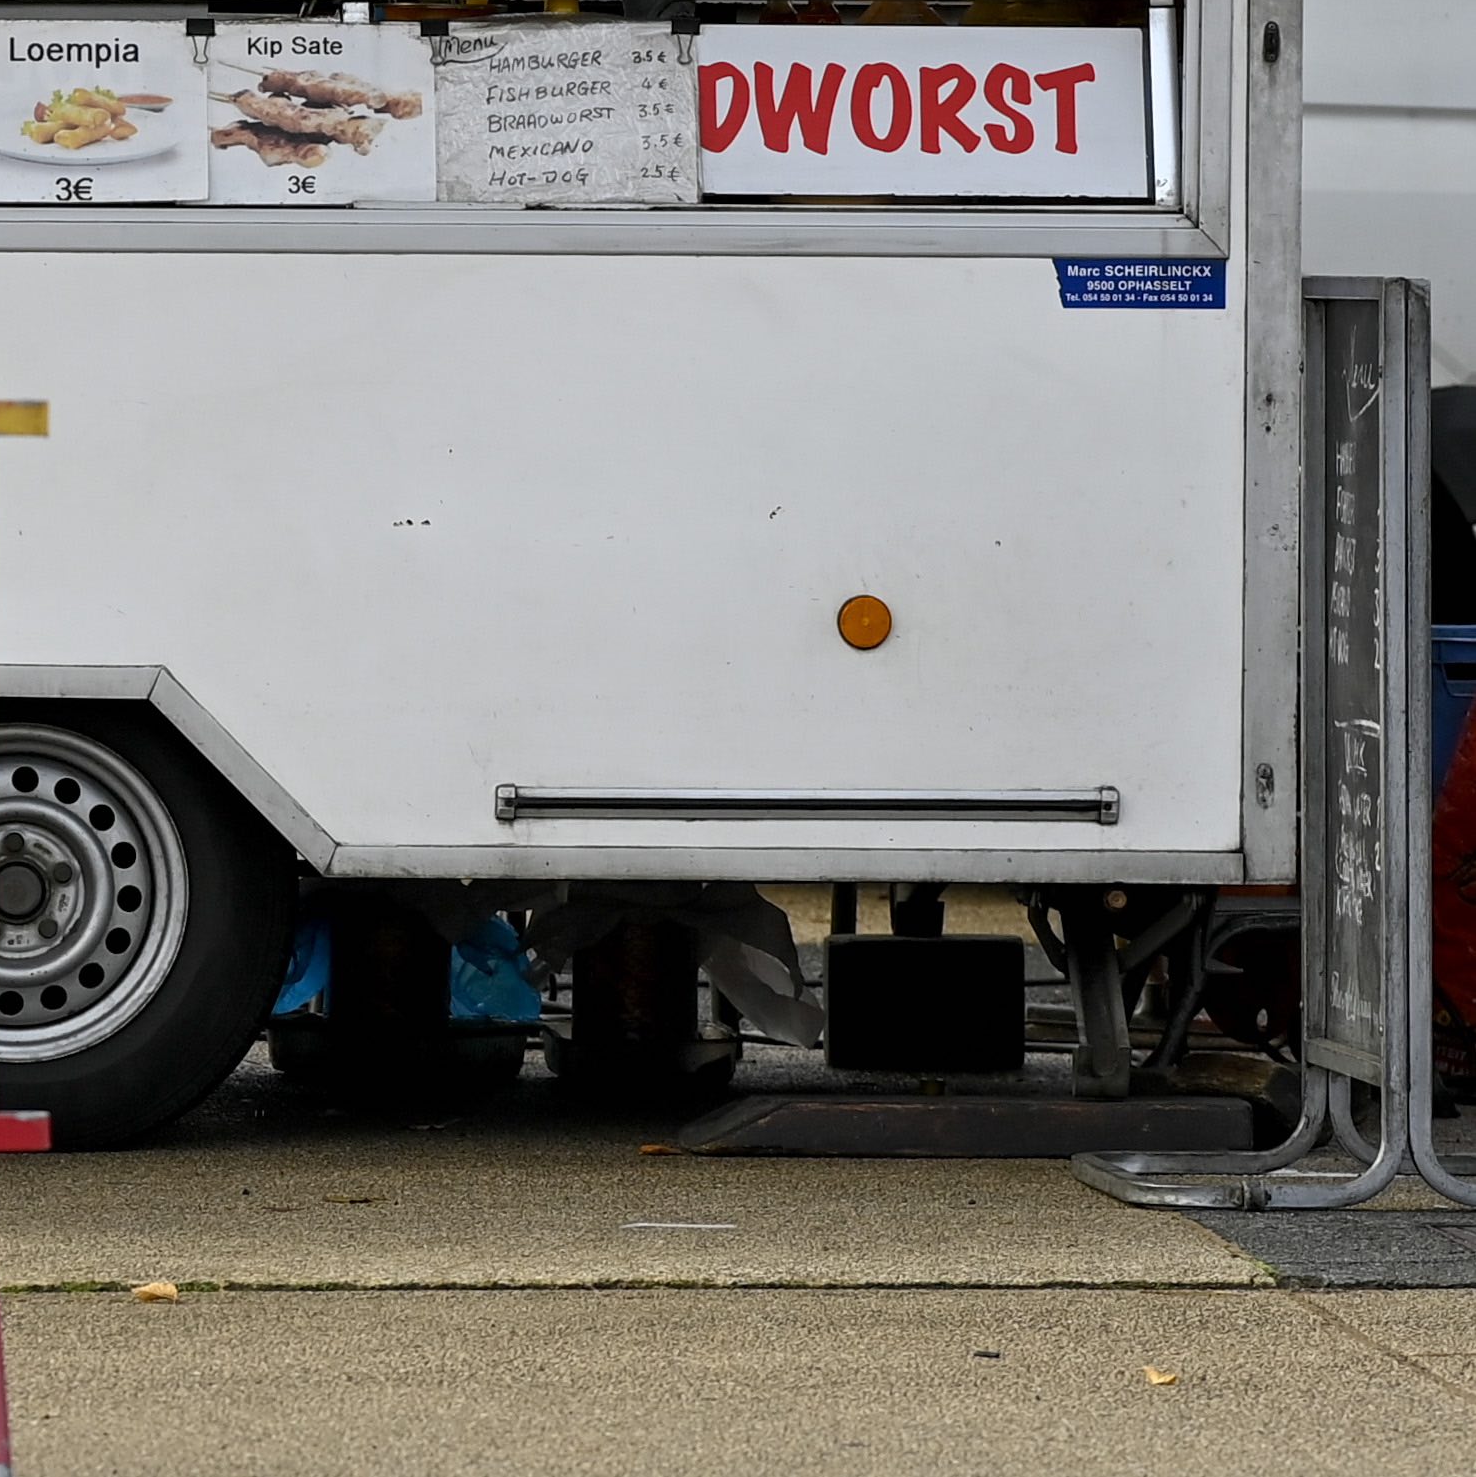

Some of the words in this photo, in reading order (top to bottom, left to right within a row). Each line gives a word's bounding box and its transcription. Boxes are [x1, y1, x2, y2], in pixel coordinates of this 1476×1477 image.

[8, 36, 140, 68] Loempia
[247, 36, 283, 59] Kip
[291, 35, 343, 56] Sate
[488, 50, 603, 73] HAMBURGER
[698, 61, 1095, 155] DWORST
[487, 107, 615, 133] BRAADWORST
[488, 137, 594, 160] MEXICANO
[54, 177, 94, 201] 3€
[287, 175, 317, 194] 3€
[1067, 265, 1101, 277] Marc
[1104, 265, 1212, 277] SCHEIRLINCKX
[1086, 280, 1115, 291] 9500
[1118, 280, 1193, 291] OPHASSELT
